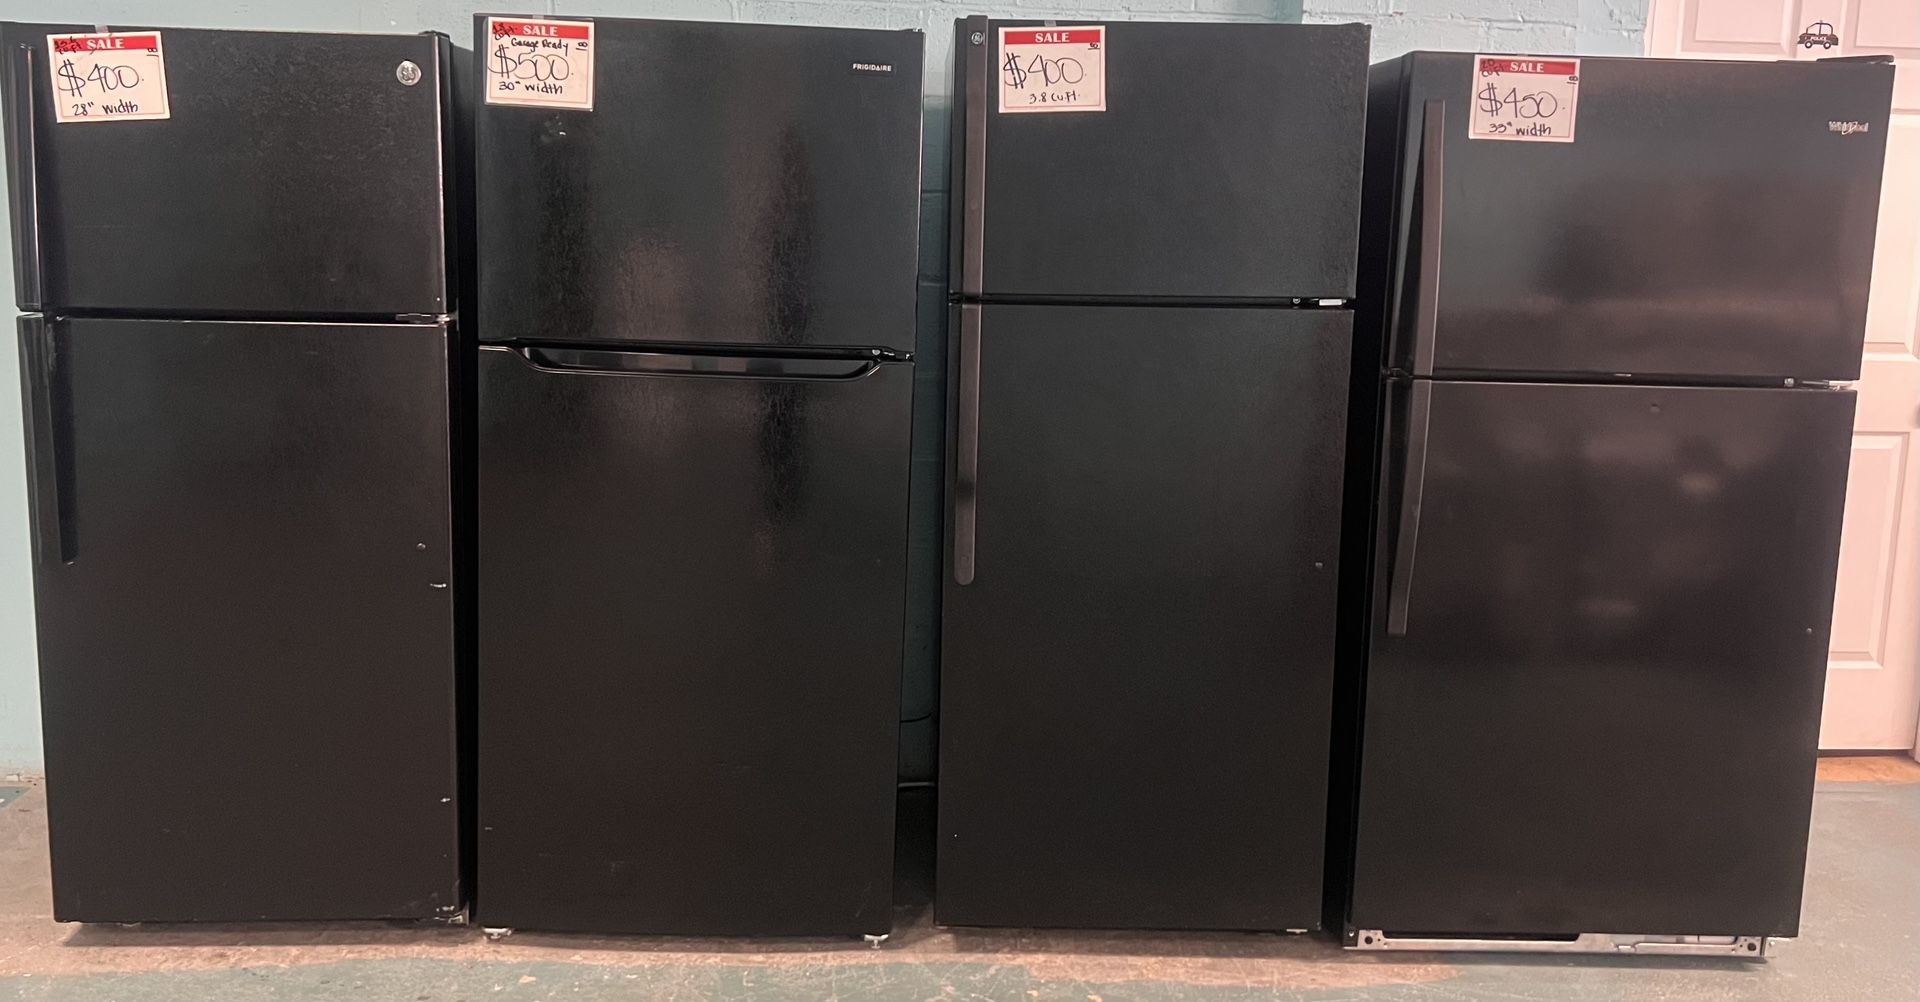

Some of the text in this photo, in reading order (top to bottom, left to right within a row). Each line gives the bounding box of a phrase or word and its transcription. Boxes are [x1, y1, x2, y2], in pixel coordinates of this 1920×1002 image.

[522, 24, 559, 37] SALE
[87, 38, 126, 50] SALE
[1035, 32, 1070, 43] SALE
[511, 37, 569, 57] Garage Ready
[852, 63, 892, 72] FRIGIDAIRE
[1509, 61, 1545, 73] SALE
[524, 81, 563, 95] width
[1028, 91, 1047, 105] 3.8
[72, 101, 95, 116] 28"
[1515, 121, 1552, 137] width
